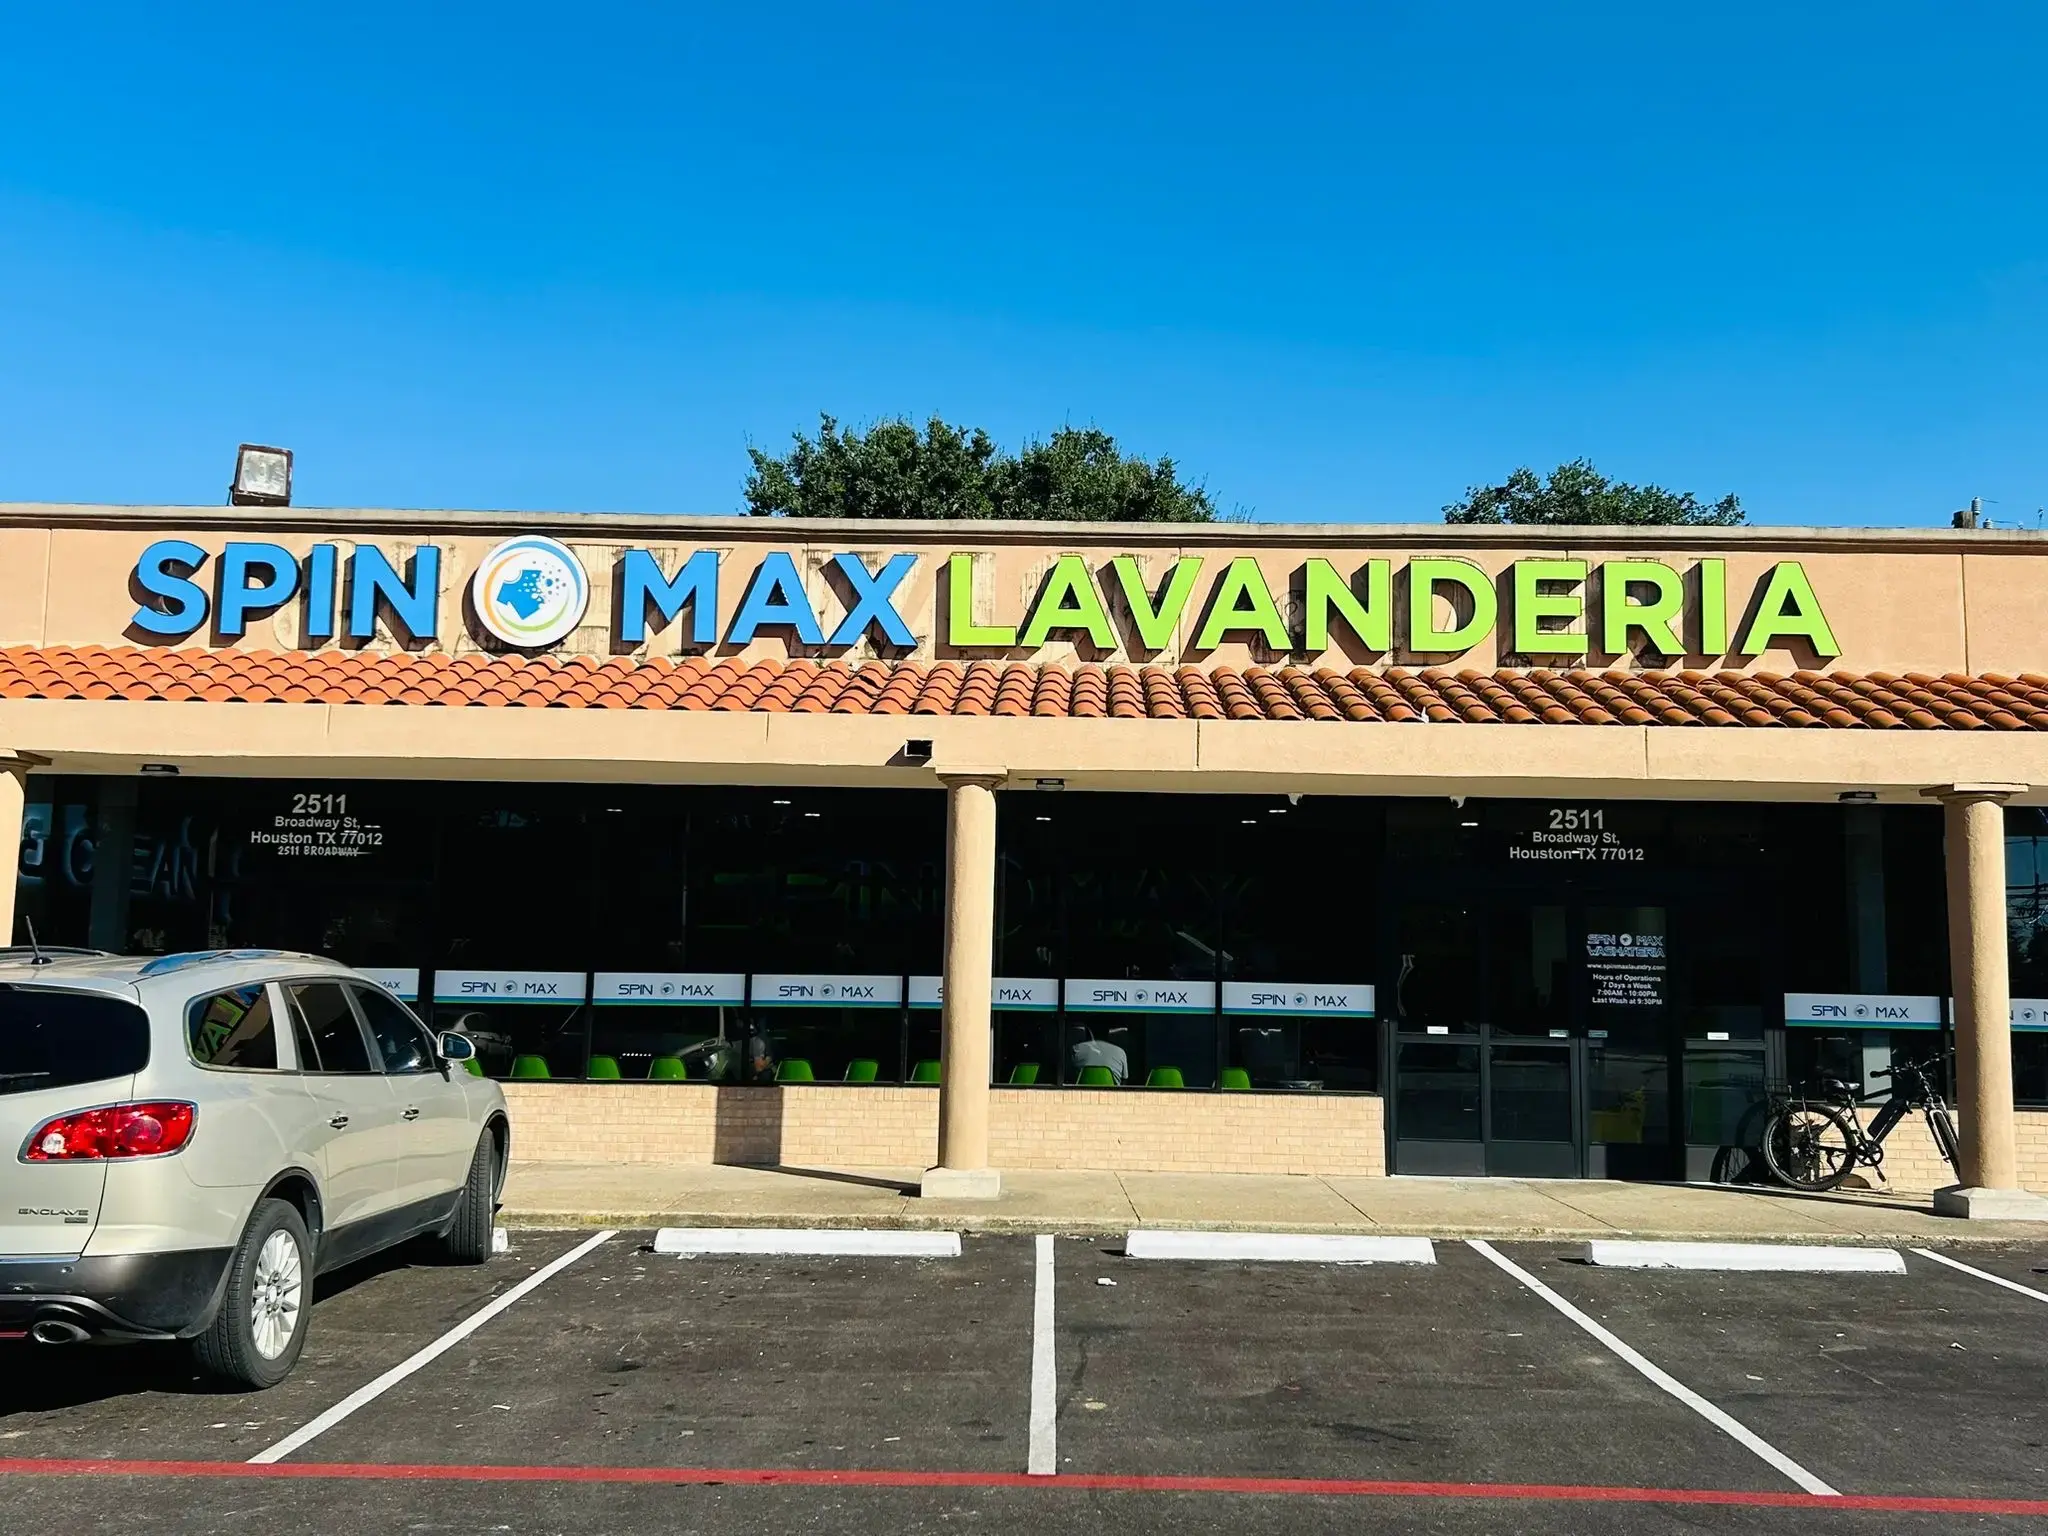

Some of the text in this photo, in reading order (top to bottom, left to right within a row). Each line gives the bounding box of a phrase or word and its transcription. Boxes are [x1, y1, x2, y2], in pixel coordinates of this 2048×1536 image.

[132, 540, 1841, 656] SPIN MAX LAVANDERIA
[292, 793, 347, 814] 2511
[274, 815, 361, 830] Broadway St,
[1549, 808, 1604, 830] 2511
[250, 831, 383, 845] Houston TX 77012
[1532, 831, 1620, 846] Broadway St,
[277, 845, 360, 857] 2511 BROADWAY
[1509, 846, 1645, 861] Houston TX 77012
[1636, 936, 1664, 946] MAX
[1586, 945, 1666, 957] WASHATERIA
[1592, 973, 1614, 981] Hours
[1623, 974, 1661, 982] Operations
[460, 981, 558, 995] SPIN MAX
[618, 984, 714, 997] SPIN MAX
[778, 985, 874, 998] SPIN MAX
[999, 989, 1032, 1000] MAX
[1092, 990, 1188, 1003] SPIN MAX
[1251, 993, 1348, 1007] SPIN MAX
[1592, 996, 1608, 1004] Last
[1811, 1005, 1910, 1019] SPIN MAX
[18, 1208, 89, 1216] ENCLAVE
